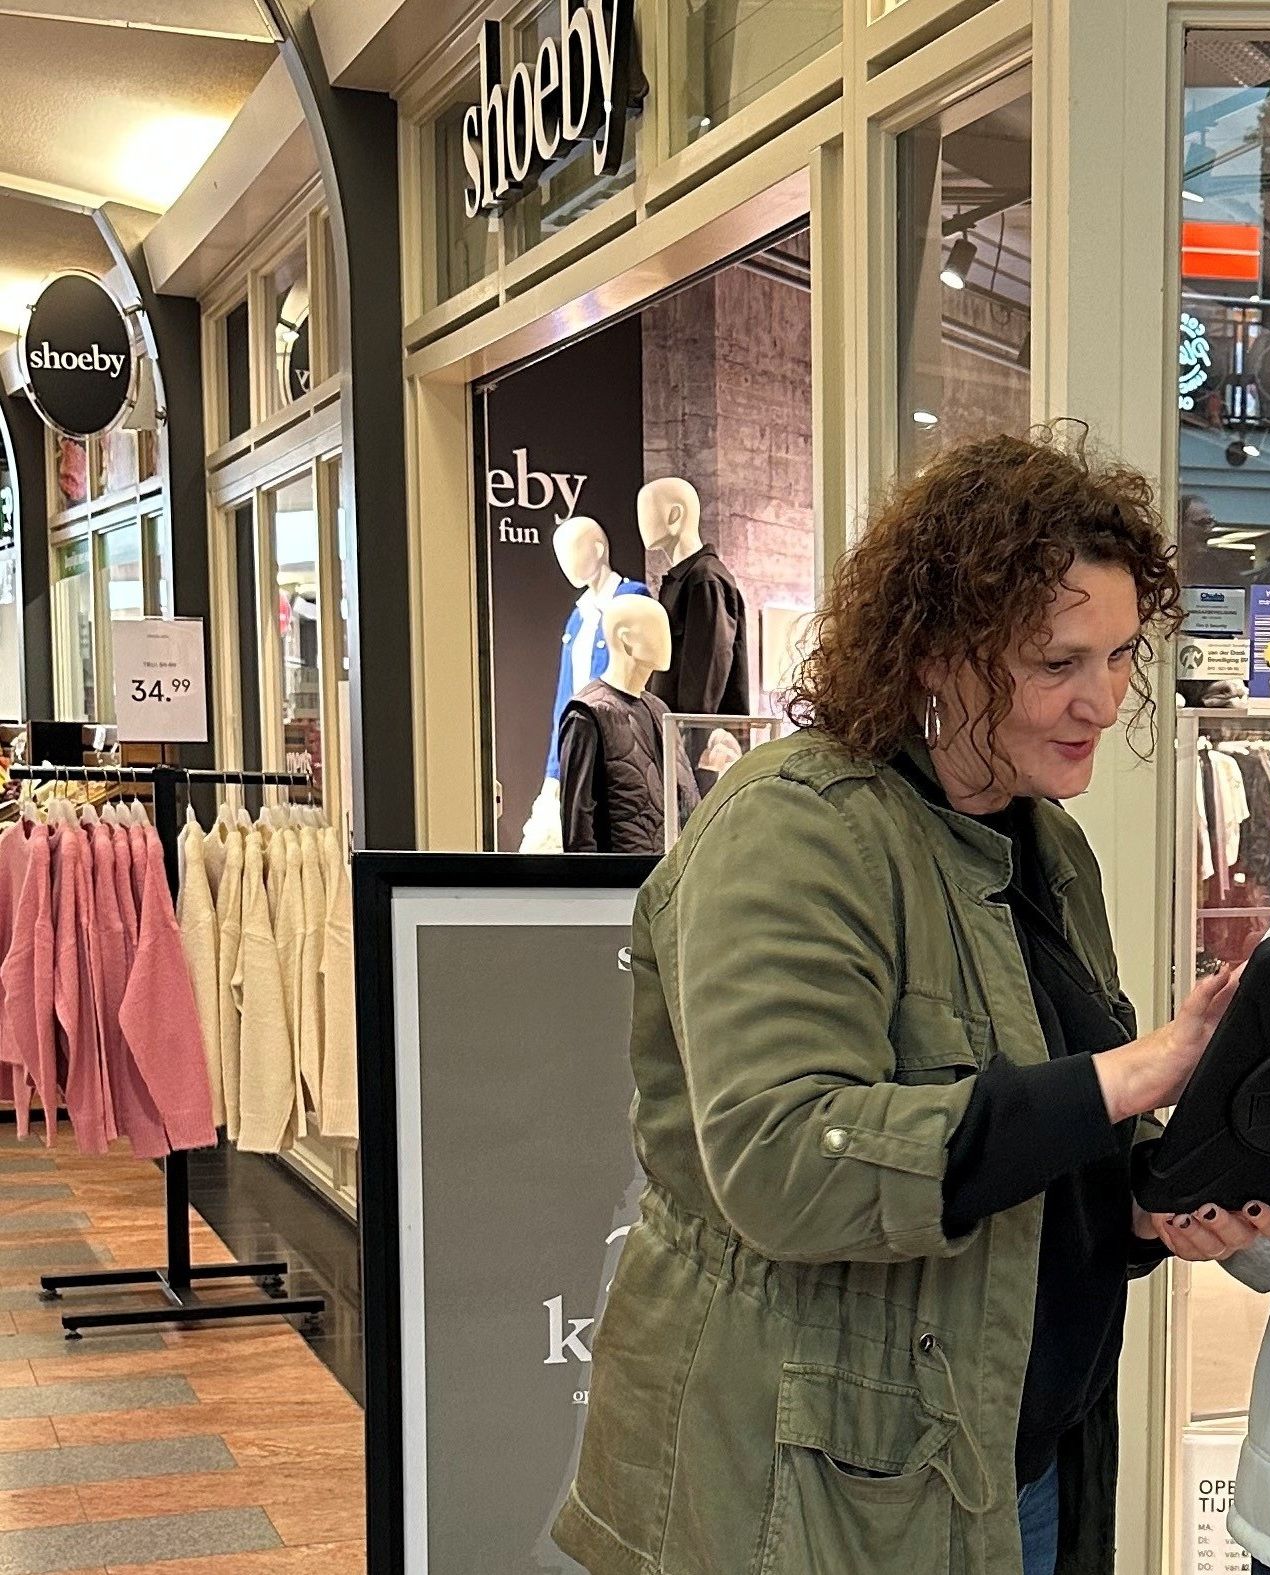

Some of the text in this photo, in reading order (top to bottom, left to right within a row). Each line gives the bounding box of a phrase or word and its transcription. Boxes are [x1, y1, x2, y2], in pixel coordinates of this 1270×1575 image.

[463, 0, 617, 218] shoeby
[29, 342, 126, 378] shoeby
[488, 447, 587, 525] eby
[499, 517, 540, 544] fun
[131, 678, 191, 702] 34.99
[542, 1294, 595, 1364] k
